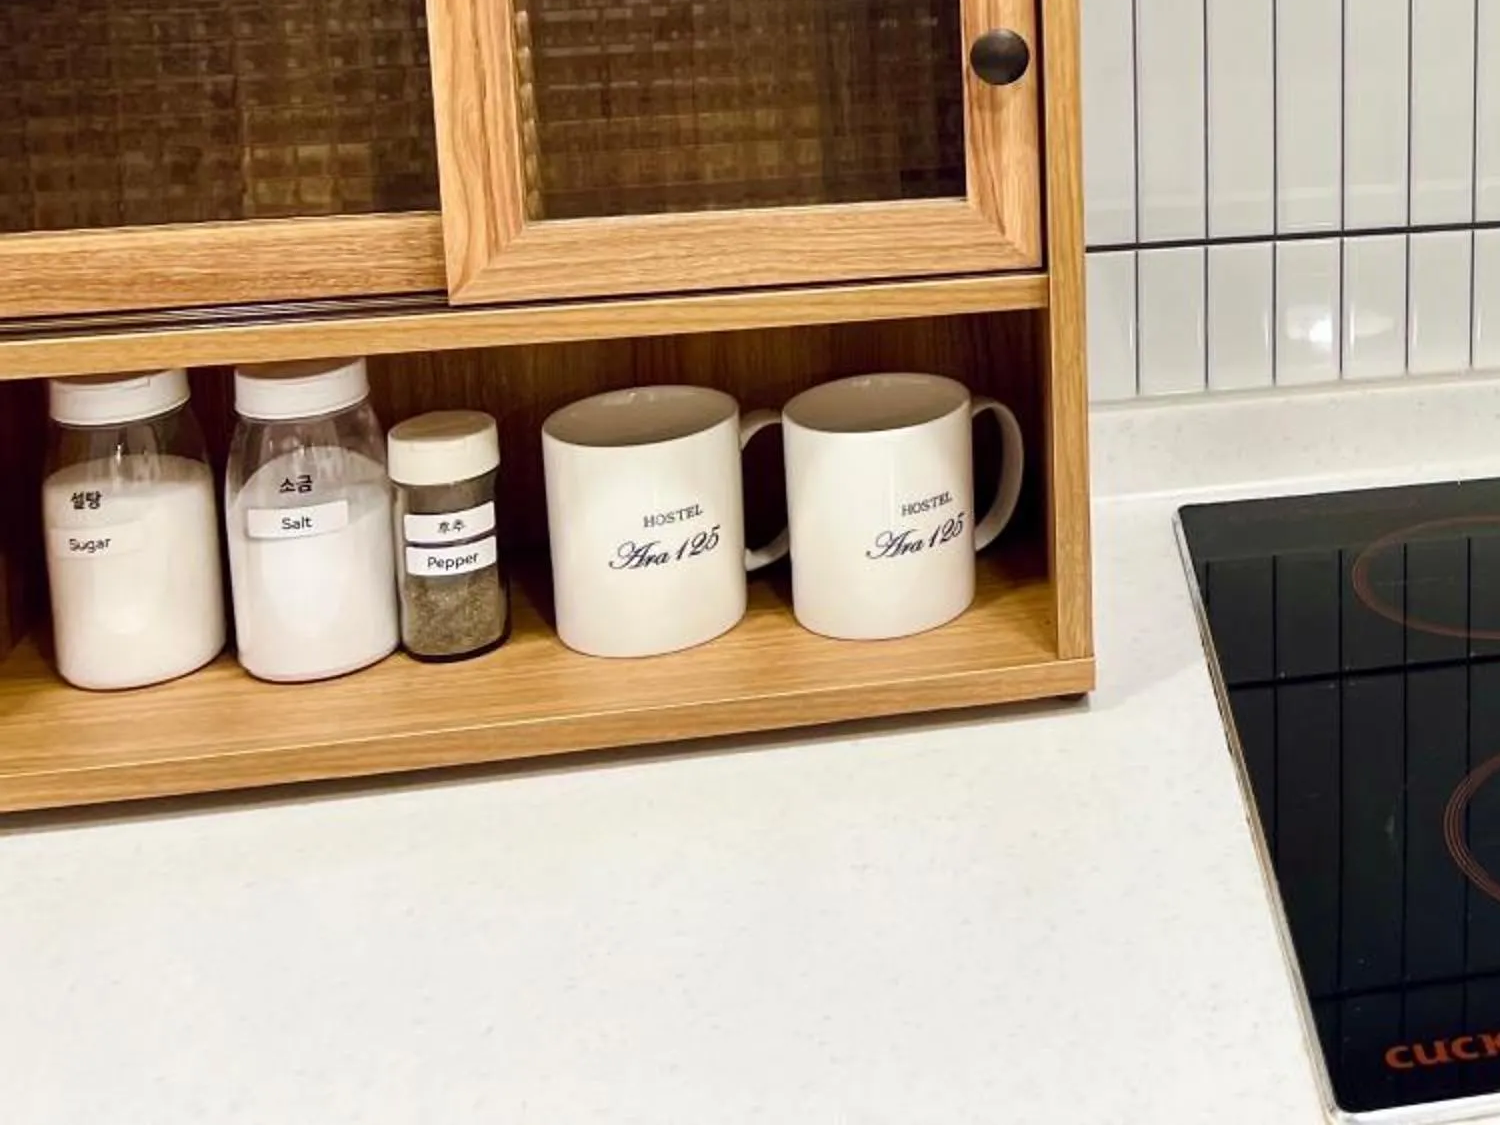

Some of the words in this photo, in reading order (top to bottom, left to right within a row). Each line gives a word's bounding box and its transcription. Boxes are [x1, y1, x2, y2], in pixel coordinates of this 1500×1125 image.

[279, 475, 313, 493] 소금
[71, 491, 103, 510] 설탕
[901, 491, 953, 516] HOSTEL
[281, 516, 312, 530] Salt
[643, 503, 703, 528] HOSTEL
[866, 528, 924, 559] Ara
[928, 512, 964, 548] 125
[69, 538, 112, 553] Sugar
[608, 540, 670, 569] Ara
[676, 524, 720, 561] 125
[427, 553, 479, 571] Pepper
